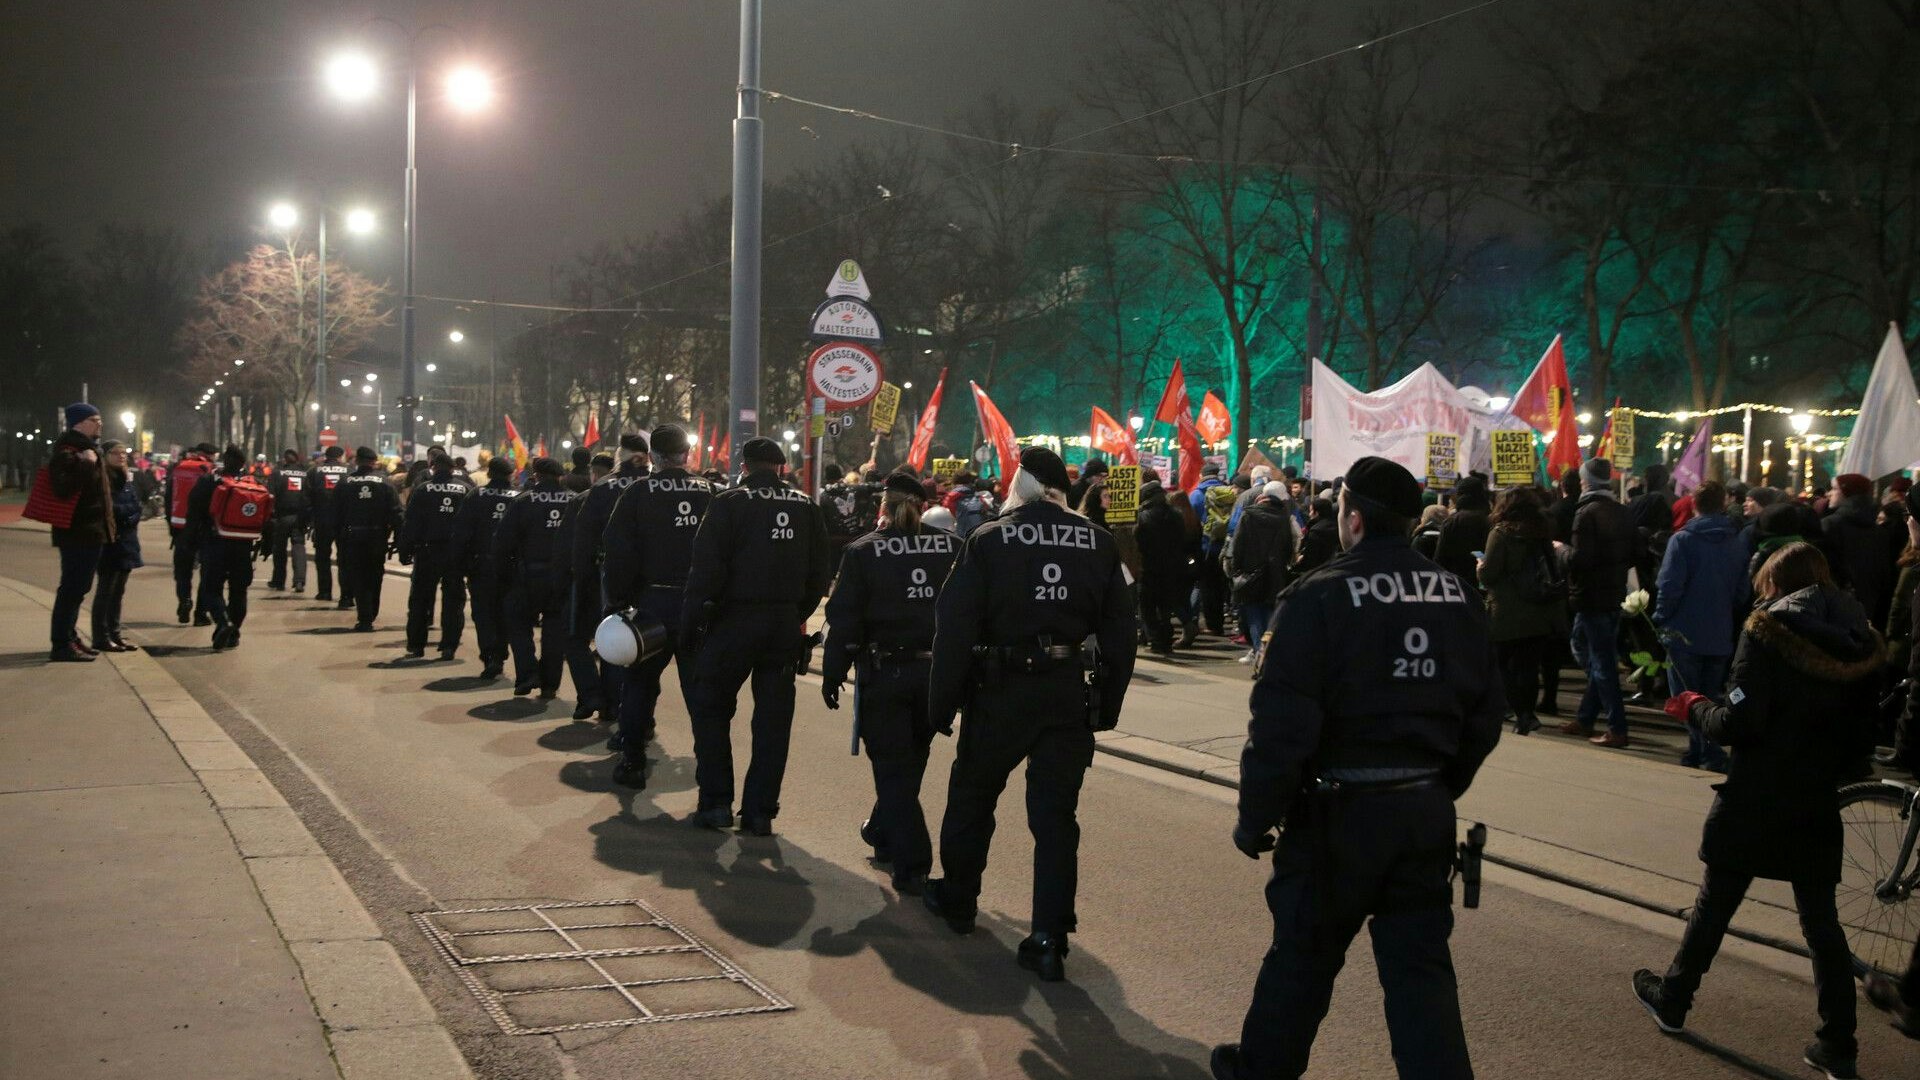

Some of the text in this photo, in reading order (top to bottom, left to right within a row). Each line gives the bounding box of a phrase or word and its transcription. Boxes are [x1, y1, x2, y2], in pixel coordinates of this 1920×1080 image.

[845, 265, 855, 277] H
[828, 302, 869, 319] AUTOBUS
[819, 324, 875, 337] HALTESTELLE
[818, 349, 873, 374] STRASSENBAHN
[819, 378, 870, 398] HALTESTELLE
[843, 415, 852, 427] D
[1429, 435, 1456, 447] LASST
[1495, 432, 1528, 443] LASST
[1430, 446, 1456, 458] NAZIS
[1496, 443, 1530, 453] NAZIS
[937, 460, 962, 470] LASST
[1429, 458, 1456, 469] NICHT
[1496, 454, 1530, 464] NICHT
[316, 465, 348, 474] POLIZEI
[1109, 467, 1137, 479] ASST
[346, 475, 383, 484] POLIZEI
[649, 477, 712, 494] POLIZEI
[1106, 479, 1137, 490] NAZIS
[426, 482, 466, 494] POLIZEI
[675, 515, 698, 527] 210
[771, 528, 794, 540] 210
[1000, 523, 1097, 550] POLIZEI
[873, 534, 953, 557] POLIZEI
[906, 586, 934, 599] 210
[1034, 585, 1068, 601] 210
[1345, 570, 1467, 608] POLIZEI
[1392, 658, 1436, 678] 210
